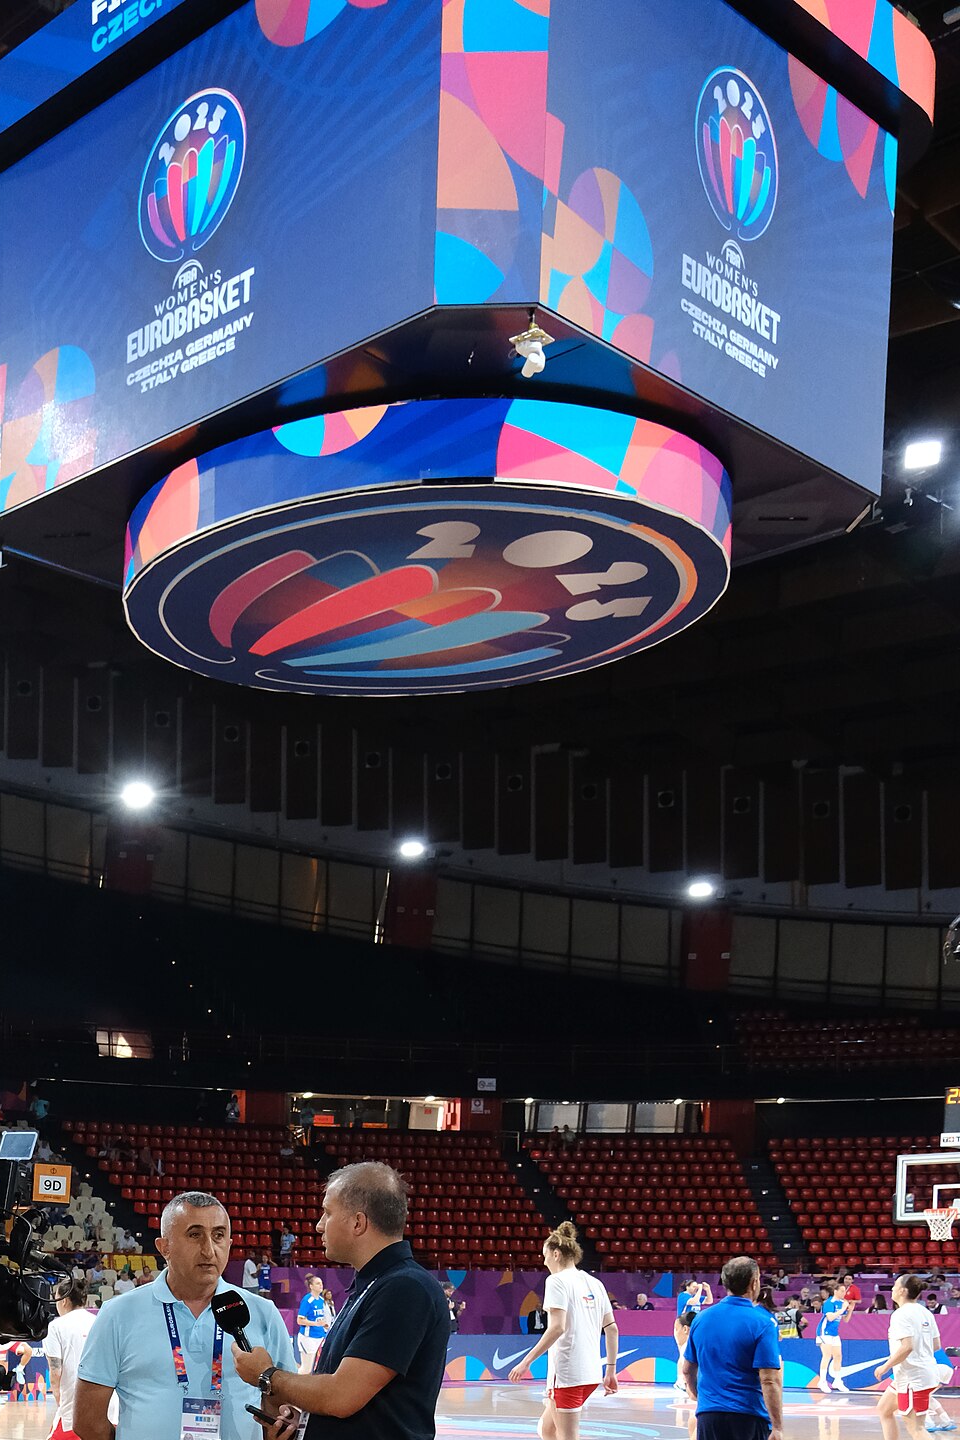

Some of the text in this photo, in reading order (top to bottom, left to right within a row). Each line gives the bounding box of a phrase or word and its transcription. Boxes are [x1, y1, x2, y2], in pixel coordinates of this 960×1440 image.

[92, 0, 162, 52] CZEC
[154, 269, 221, 316] WOMEN'S
[682, 253, 780, 344] EUROBASKET
[706, 251, 758, 296] WOMEN'S
[127, 267, 254, 364] EUROBASKET
[681, 298, 778, 369] CZECHIA GERMANY
[127, 312, 254, 386] CZECHIA GERMANY
[141, 337, 235, 393] ITALY GREECE
[693, 320, 766, 378] ITALY GREECE
[44, 1180, 62, 1191] 9D
